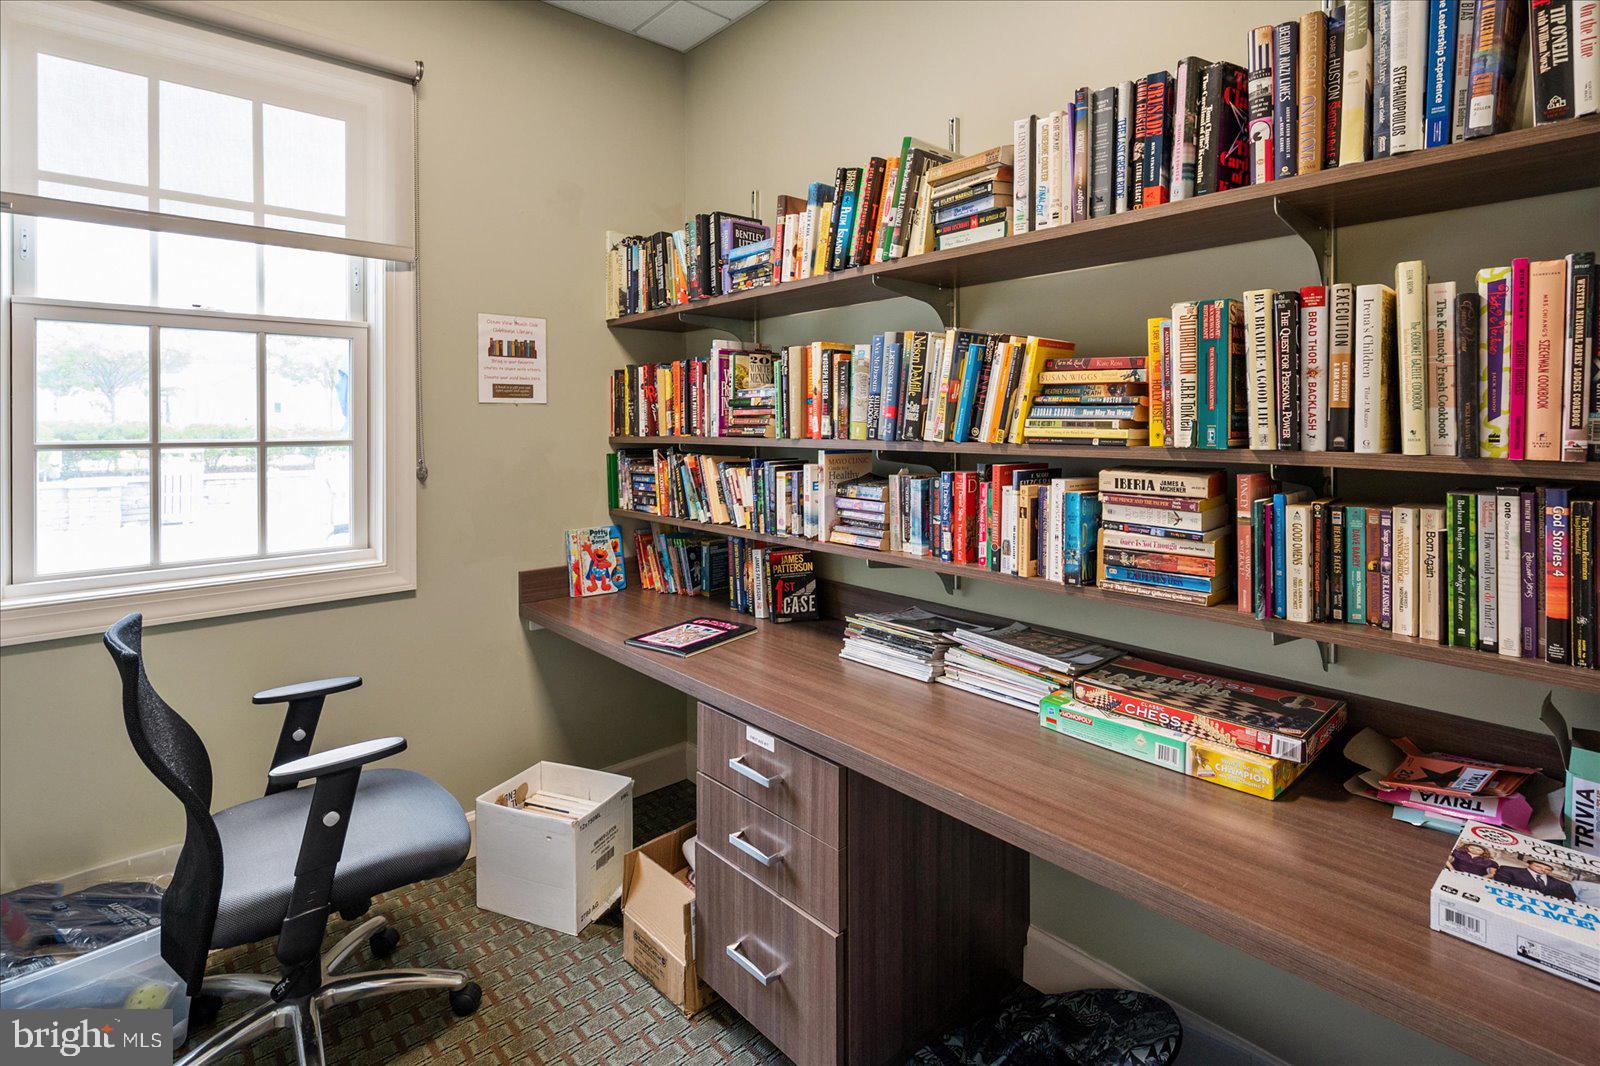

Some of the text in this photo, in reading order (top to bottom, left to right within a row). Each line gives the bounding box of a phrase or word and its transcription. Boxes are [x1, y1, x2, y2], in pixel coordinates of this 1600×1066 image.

[1461, 3, 1473, 20] BIAS
[1550, 5, 1566, 24] TIP
[1538, 26, 1548, 52] William
[1581, 4, 1599, 57] On the Line
[1279, 25, 1291, 102] BEHIND NAZI LINES
[1329, 36, 1340, 100] CHARLIE HUSTON
[1435, 10, 1447, 103] Leadership Experience
[1136, 80, 1146, 101] LINDA
[1392, 67, 1407, 136] STEPHANOPOULOS
[1135, 103, 1146, 138] FAIRSTEIN
[1146, 82, 1164, 137] CRUSADE
[1200, 91, 1208, 126] Cardinal
[1041, 125, 1049, 155] CATHERINE
[1197, 148, 1205, 183] Kremlin
[1036, 204, 1044, 216] CUT
[1076, 189, 1084, 215] Azinger
[735, 229, 764, 241] BENTLEY
[835, 207, 851, 254] PLUM ISLAND
[1254, 294, 1265, 314] BEN
[1335, 288, 1350, 346] EXECUTION
[1179, 315, 1197, 374] SILMARILLION
[1255, 317, 1266, 361] BRADLEE
[1363, 299, 1374, 378] Irena's Children
[1572, 279, 1586, 426] WESTERN NATIONAL LODGES COOKBOOK
[750, 356, 770, 364] 20
[750, 365, 770, 373] MINUTE
[908, 335, 926, 397] Nelson DeMille
[1280, 310, 1291, 438] THE QUEST FOR PERSONAL POWER
[1308, 312, 1317, 430] BRAD THOR BACKLASH
[1410, 332, 1422, 411] GOURMET GAZELLE COOKBOOK
[1435, 299, 1448, 439] The Kentucky Fresh Cookbook
[1537, 340, 1550, 409] SZECHWAN COOKBOOK
[750, 373, 770, 384] MENUS
[1041, 373, 1068, 381] SUSAN
[1257, 376, 1267, 403] GOOD
[1152, 379, 1162, 423] HOLLY LISLE
[1258, 407, 1268, 428] LIFE
[1114, 477, 1155, 491] IBERIA
[1240, 478, 1248, 508] YANCEY
[1504, 502, 1512, 519] one
[1552, 506, 1565, 527] God
[1292, 523, 1303, 565] GOOD OMENS
[1333, 526, 1342, 574] HEARING FACES
[1351, 529, 1360, 568] DAVE BARRY
[1424, 531, 1435, 578] Born Again
[1455, 527, 1465, 560] Kingsolver
[1552, 530, 1565, 567] Stories
[1581, 528, 1589, 551] Protestant
[773, 562, 813, 573] PATTERSON
[781, 554, 803, 565] JAMES
[1481, 532, 1495, 603] How could you do
[1581, 552, 1589, 580] Reformation
[1382, 574, 1390, 585] JOE
[1455, 565, 1465, 594] Prodigal
[783, 594, 816, 613] CASE
[1181, 673, 1256, 694] CHESS
[1060, 710, 1093, 725] MONOPOLY
[1124, 703, 1181, 728] CHESS
[1140, 701, 1165, 713] CLASSIC
[1215, 762, 1270, 785] CHAMPION
[1419, 791, 1485, 813] TRIVIA
[1574, 788, 1595, 848] TRIVIA
[1485, 885, 1600, 924] TRIVIA
[1495, 897, 1596, 931] GAME
